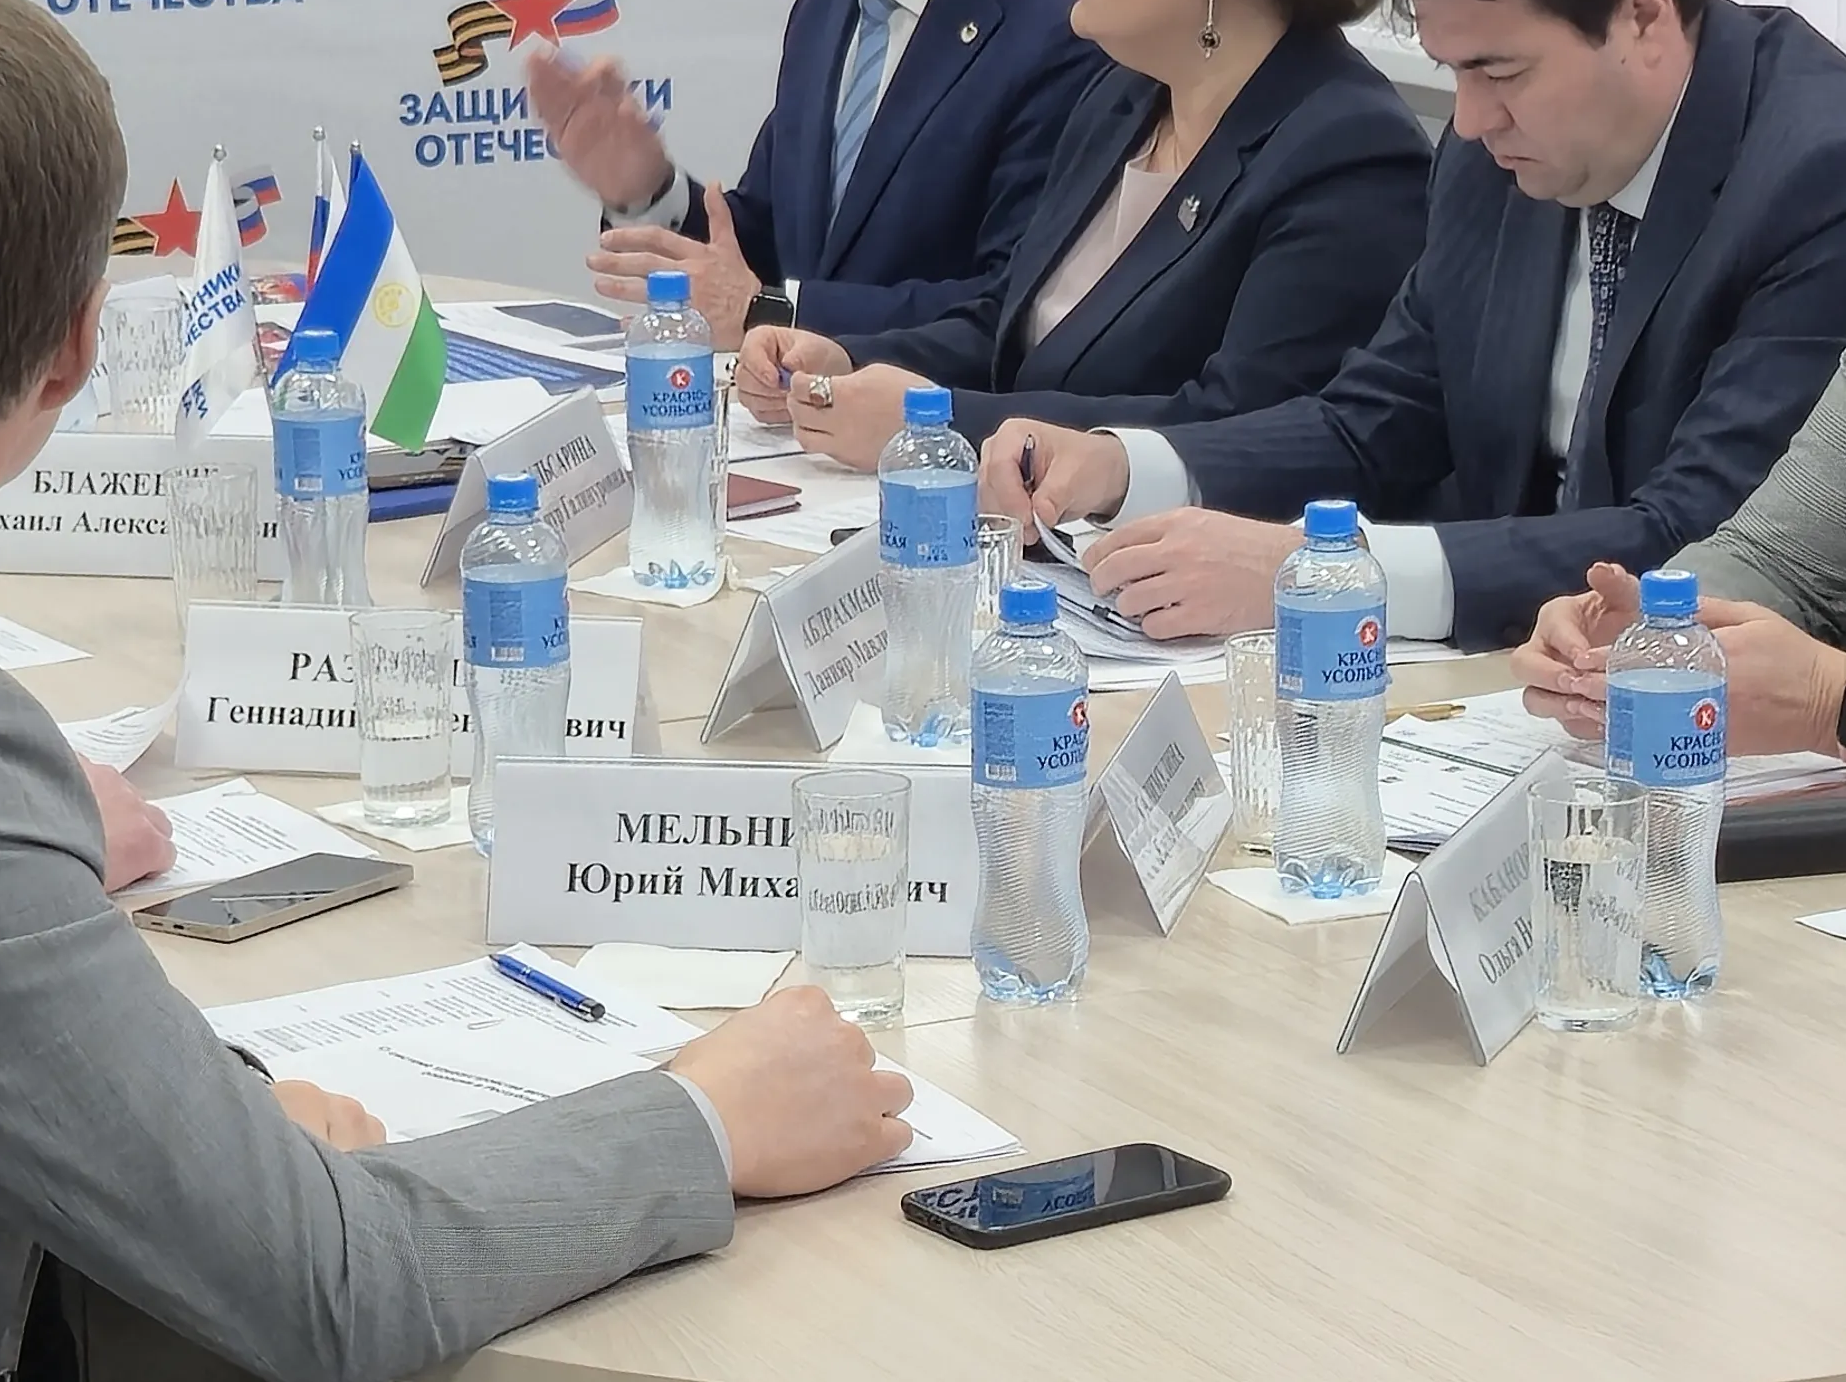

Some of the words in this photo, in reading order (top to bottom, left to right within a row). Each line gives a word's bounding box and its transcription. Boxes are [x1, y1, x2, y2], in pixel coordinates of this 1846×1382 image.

[397, 76, 673, 126] ЗАЩИИ
[566, 861, 684, 903] Юрий
[1478, 935, 1524, 985] Ольга
